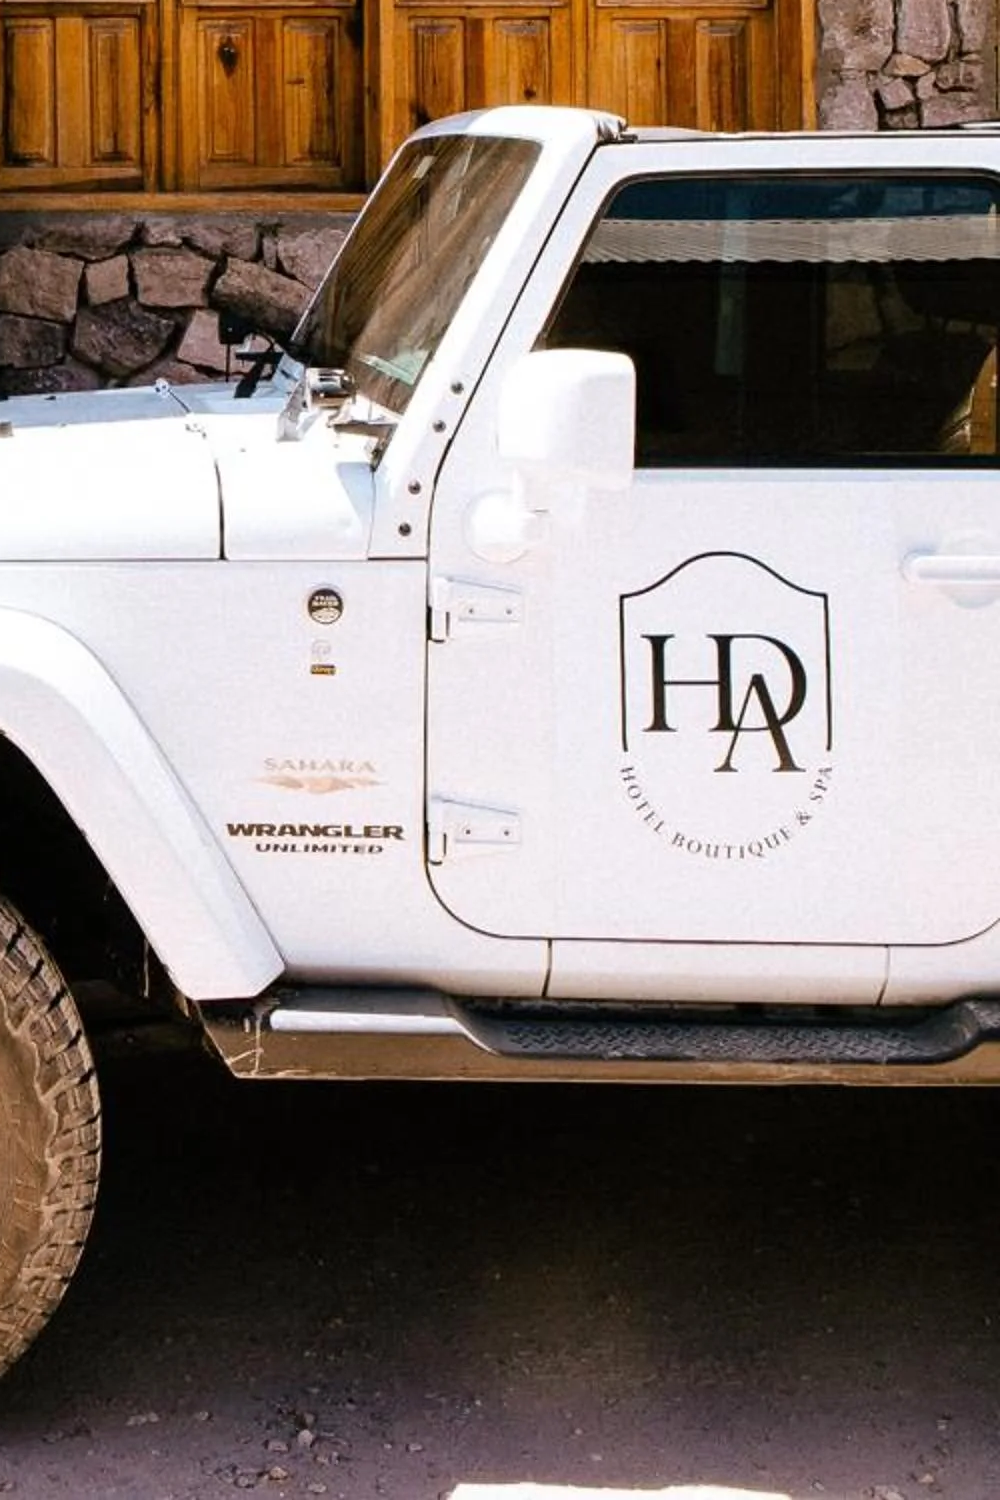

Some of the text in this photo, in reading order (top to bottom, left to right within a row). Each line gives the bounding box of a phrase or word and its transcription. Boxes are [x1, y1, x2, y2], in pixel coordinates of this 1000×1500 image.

[263, 757, 377, 773] SAHARA
[619, 766, 833, 860] HOTEL BOUTIQUE & SPA
[226, 823, 405, 841] WRANGLER
[255, 843, 384, 854] UNLIMITED
